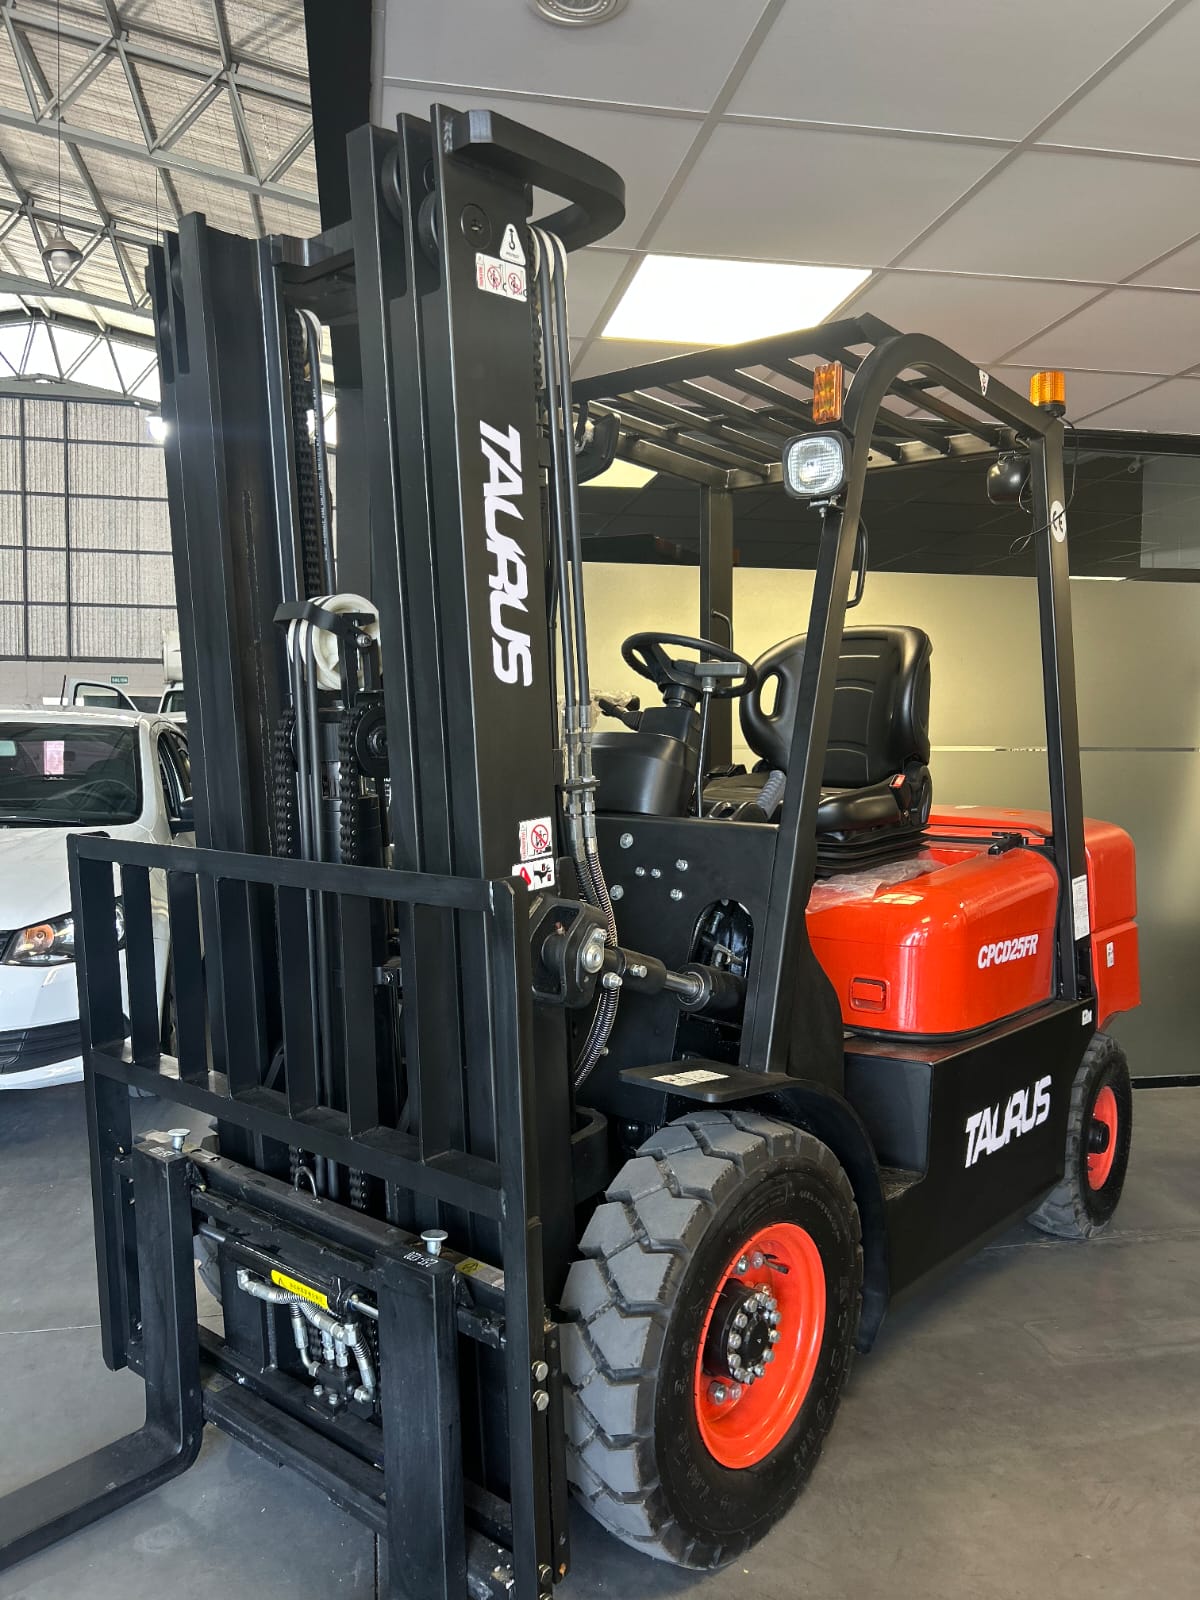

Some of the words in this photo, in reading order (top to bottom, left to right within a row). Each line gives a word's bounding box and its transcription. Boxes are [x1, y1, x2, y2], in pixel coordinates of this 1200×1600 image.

[479, 419, 534, 688] TAURUS
[977, 933, 1039, 969] CPCD25FR
[965, 1074, 1052, 1169] TAURUS
